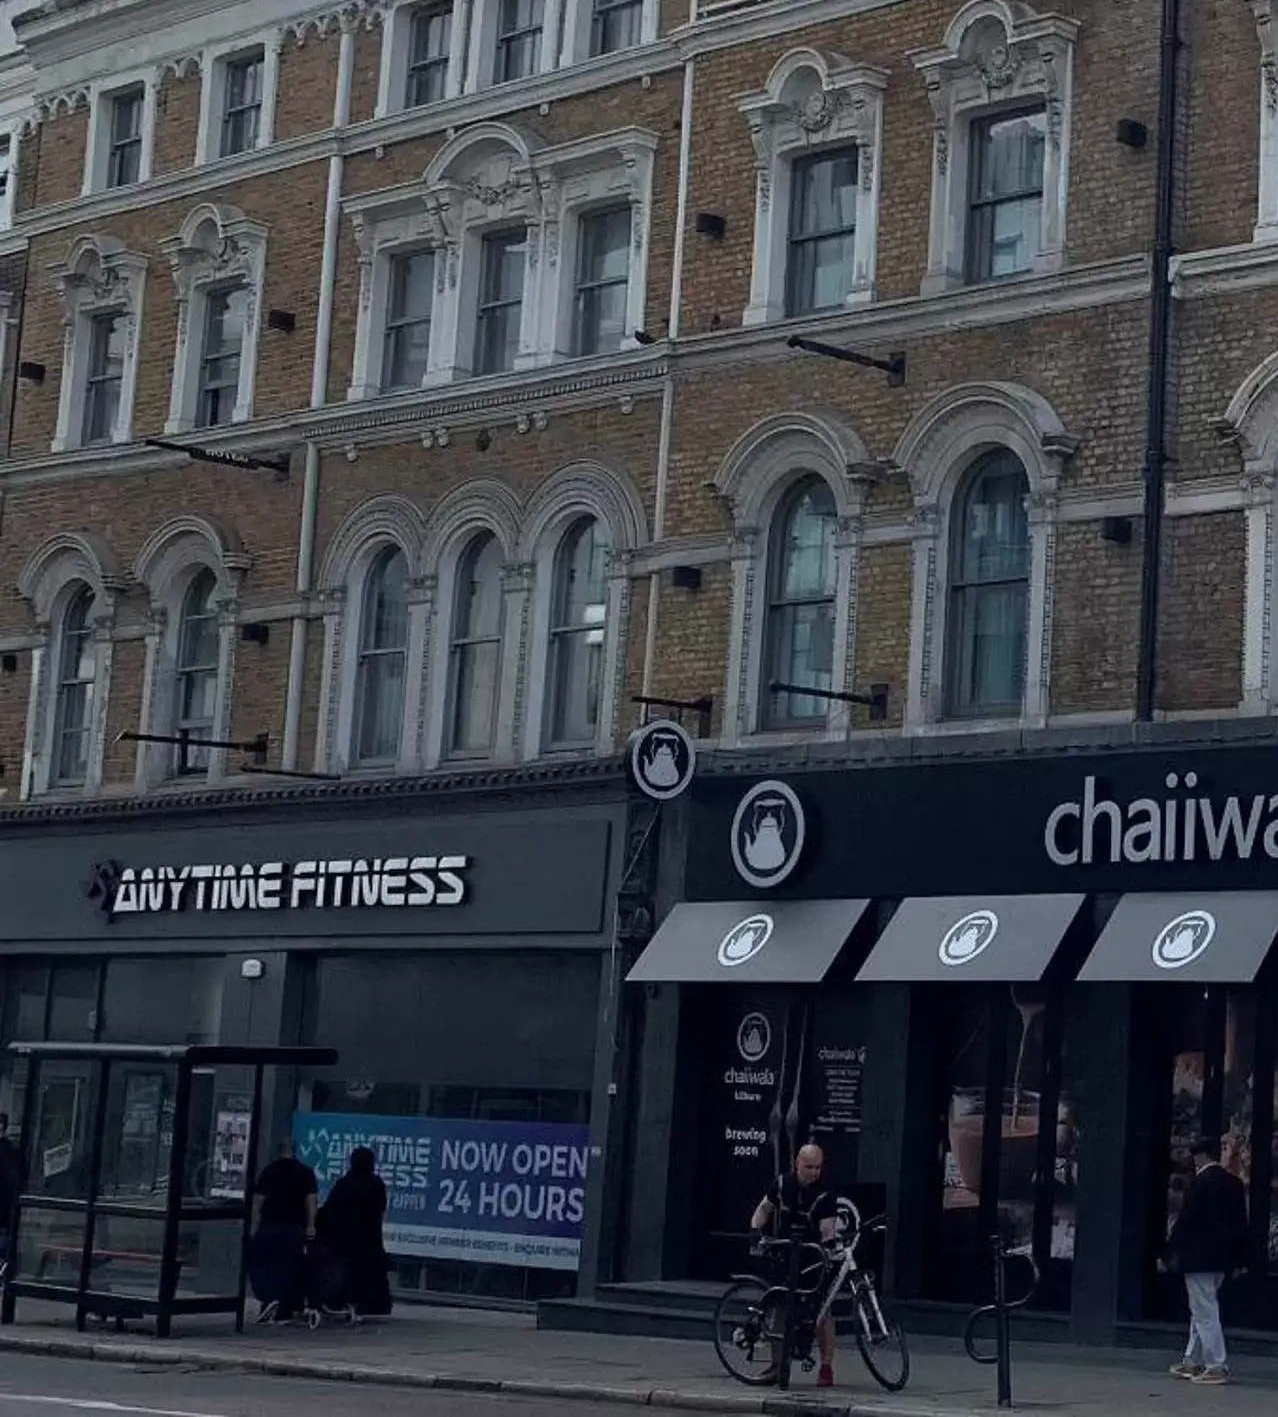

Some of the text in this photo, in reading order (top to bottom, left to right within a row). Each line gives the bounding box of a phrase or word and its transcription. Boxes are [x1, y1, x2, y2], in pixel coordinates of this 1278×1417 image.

[113, 855, 467, 912] ANYTIME FITNESS
[724, 1126, 767, 1144] brewing
[732, 1145, 759, 1158] soon
[440, 1139, 588, 1179] NOW OPEN
[437, 1178, 472, 1214] 24
[478, 1181, 586, 1223] HOURS
